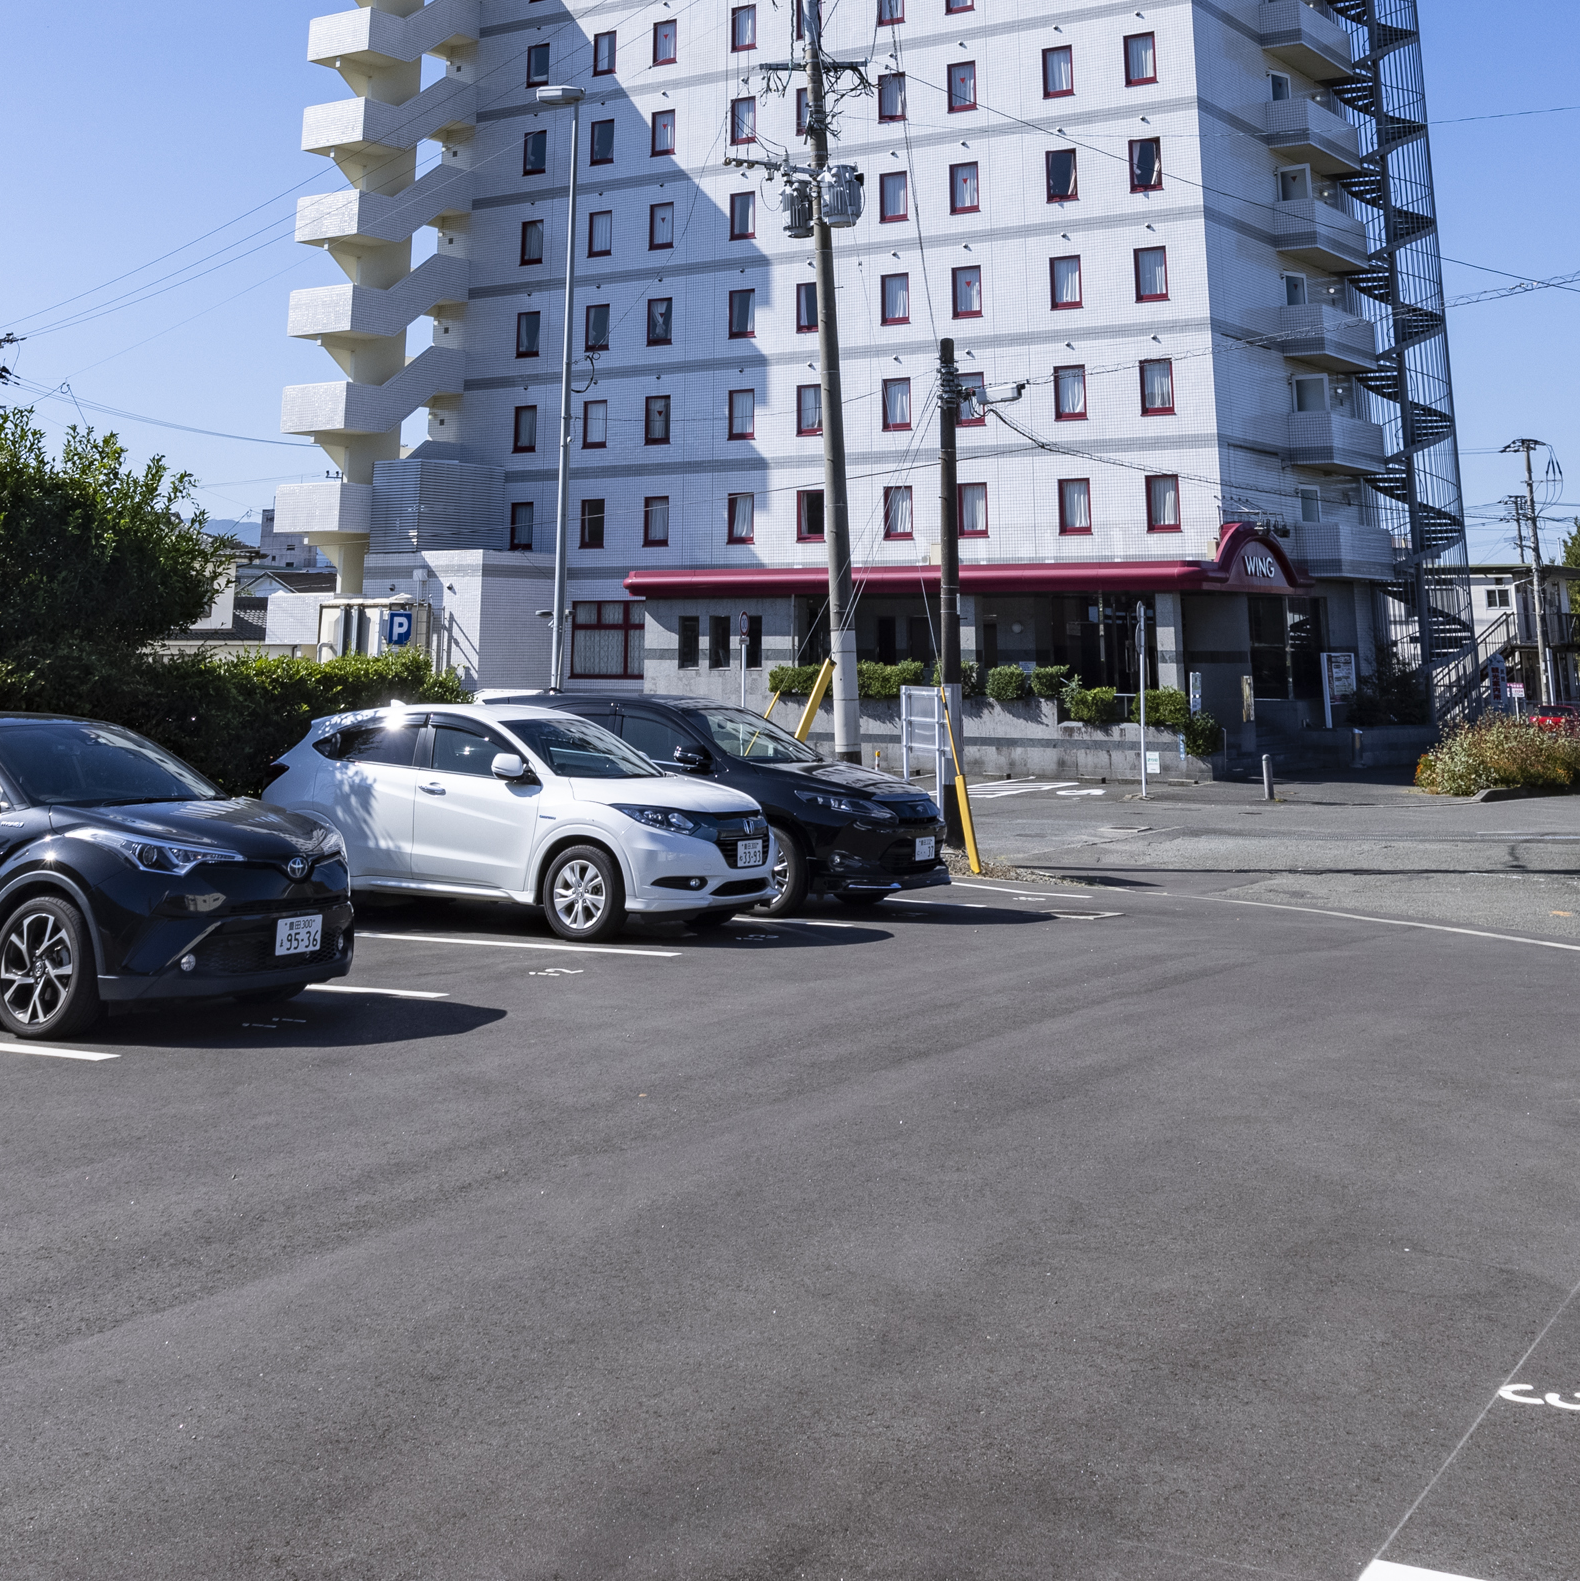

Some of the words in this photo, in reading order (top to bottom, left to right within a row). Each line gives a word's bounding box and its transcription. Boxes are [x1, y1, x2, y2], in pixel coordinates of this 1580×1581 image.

[1242, 555, 1275, 578] WING
[392, 616, 409, 641] P
[285, 929, 319, 951] 95-36
